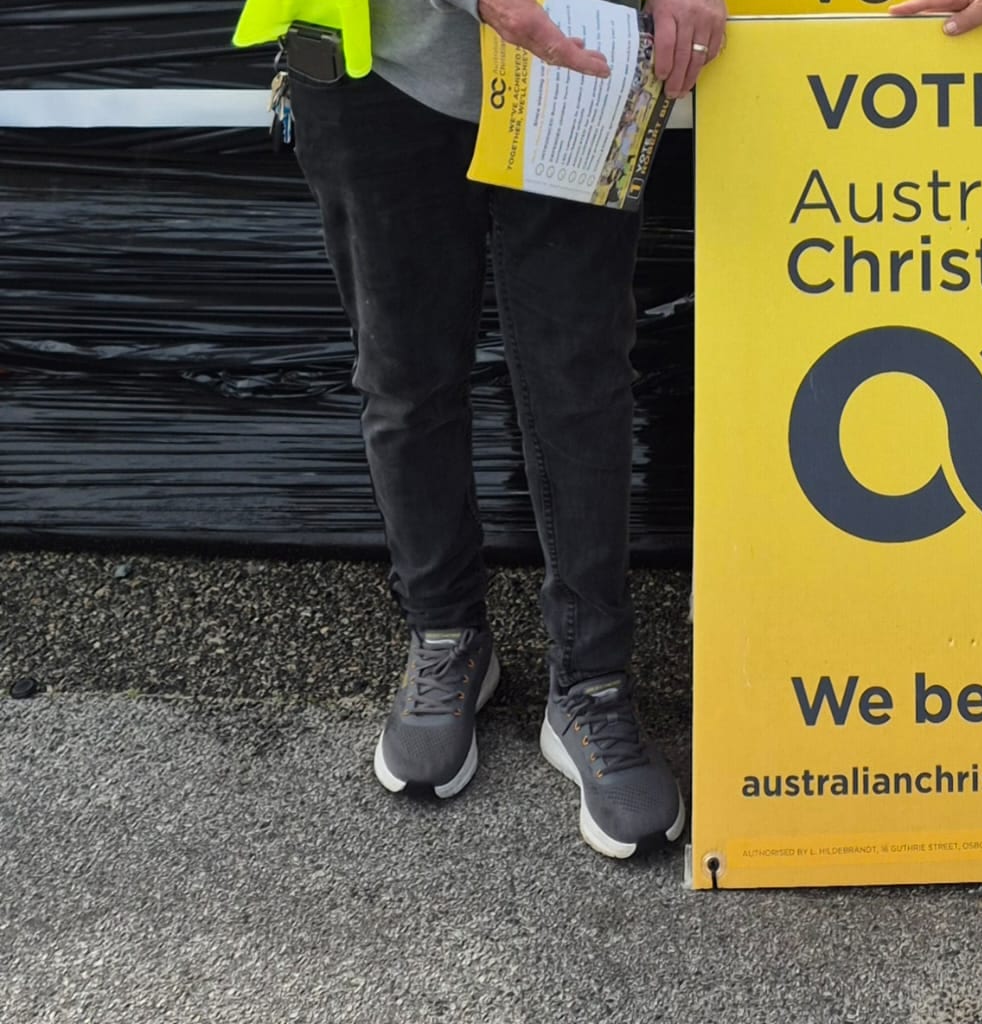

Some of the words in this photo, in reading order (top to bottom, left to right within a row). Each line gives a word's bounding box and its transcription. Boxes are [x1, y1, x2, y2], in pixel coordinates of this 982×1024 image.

[791, 676, 893, 726] We
[743, 848, 794, 857] AUTHORISED
[797, 848, 807, 856] BY
[819, 846, 879, 855] HILDEBRANDT,
[890, 843, 925, 852] GUTHRIE
[928, 842, 961, 851] STREET,
